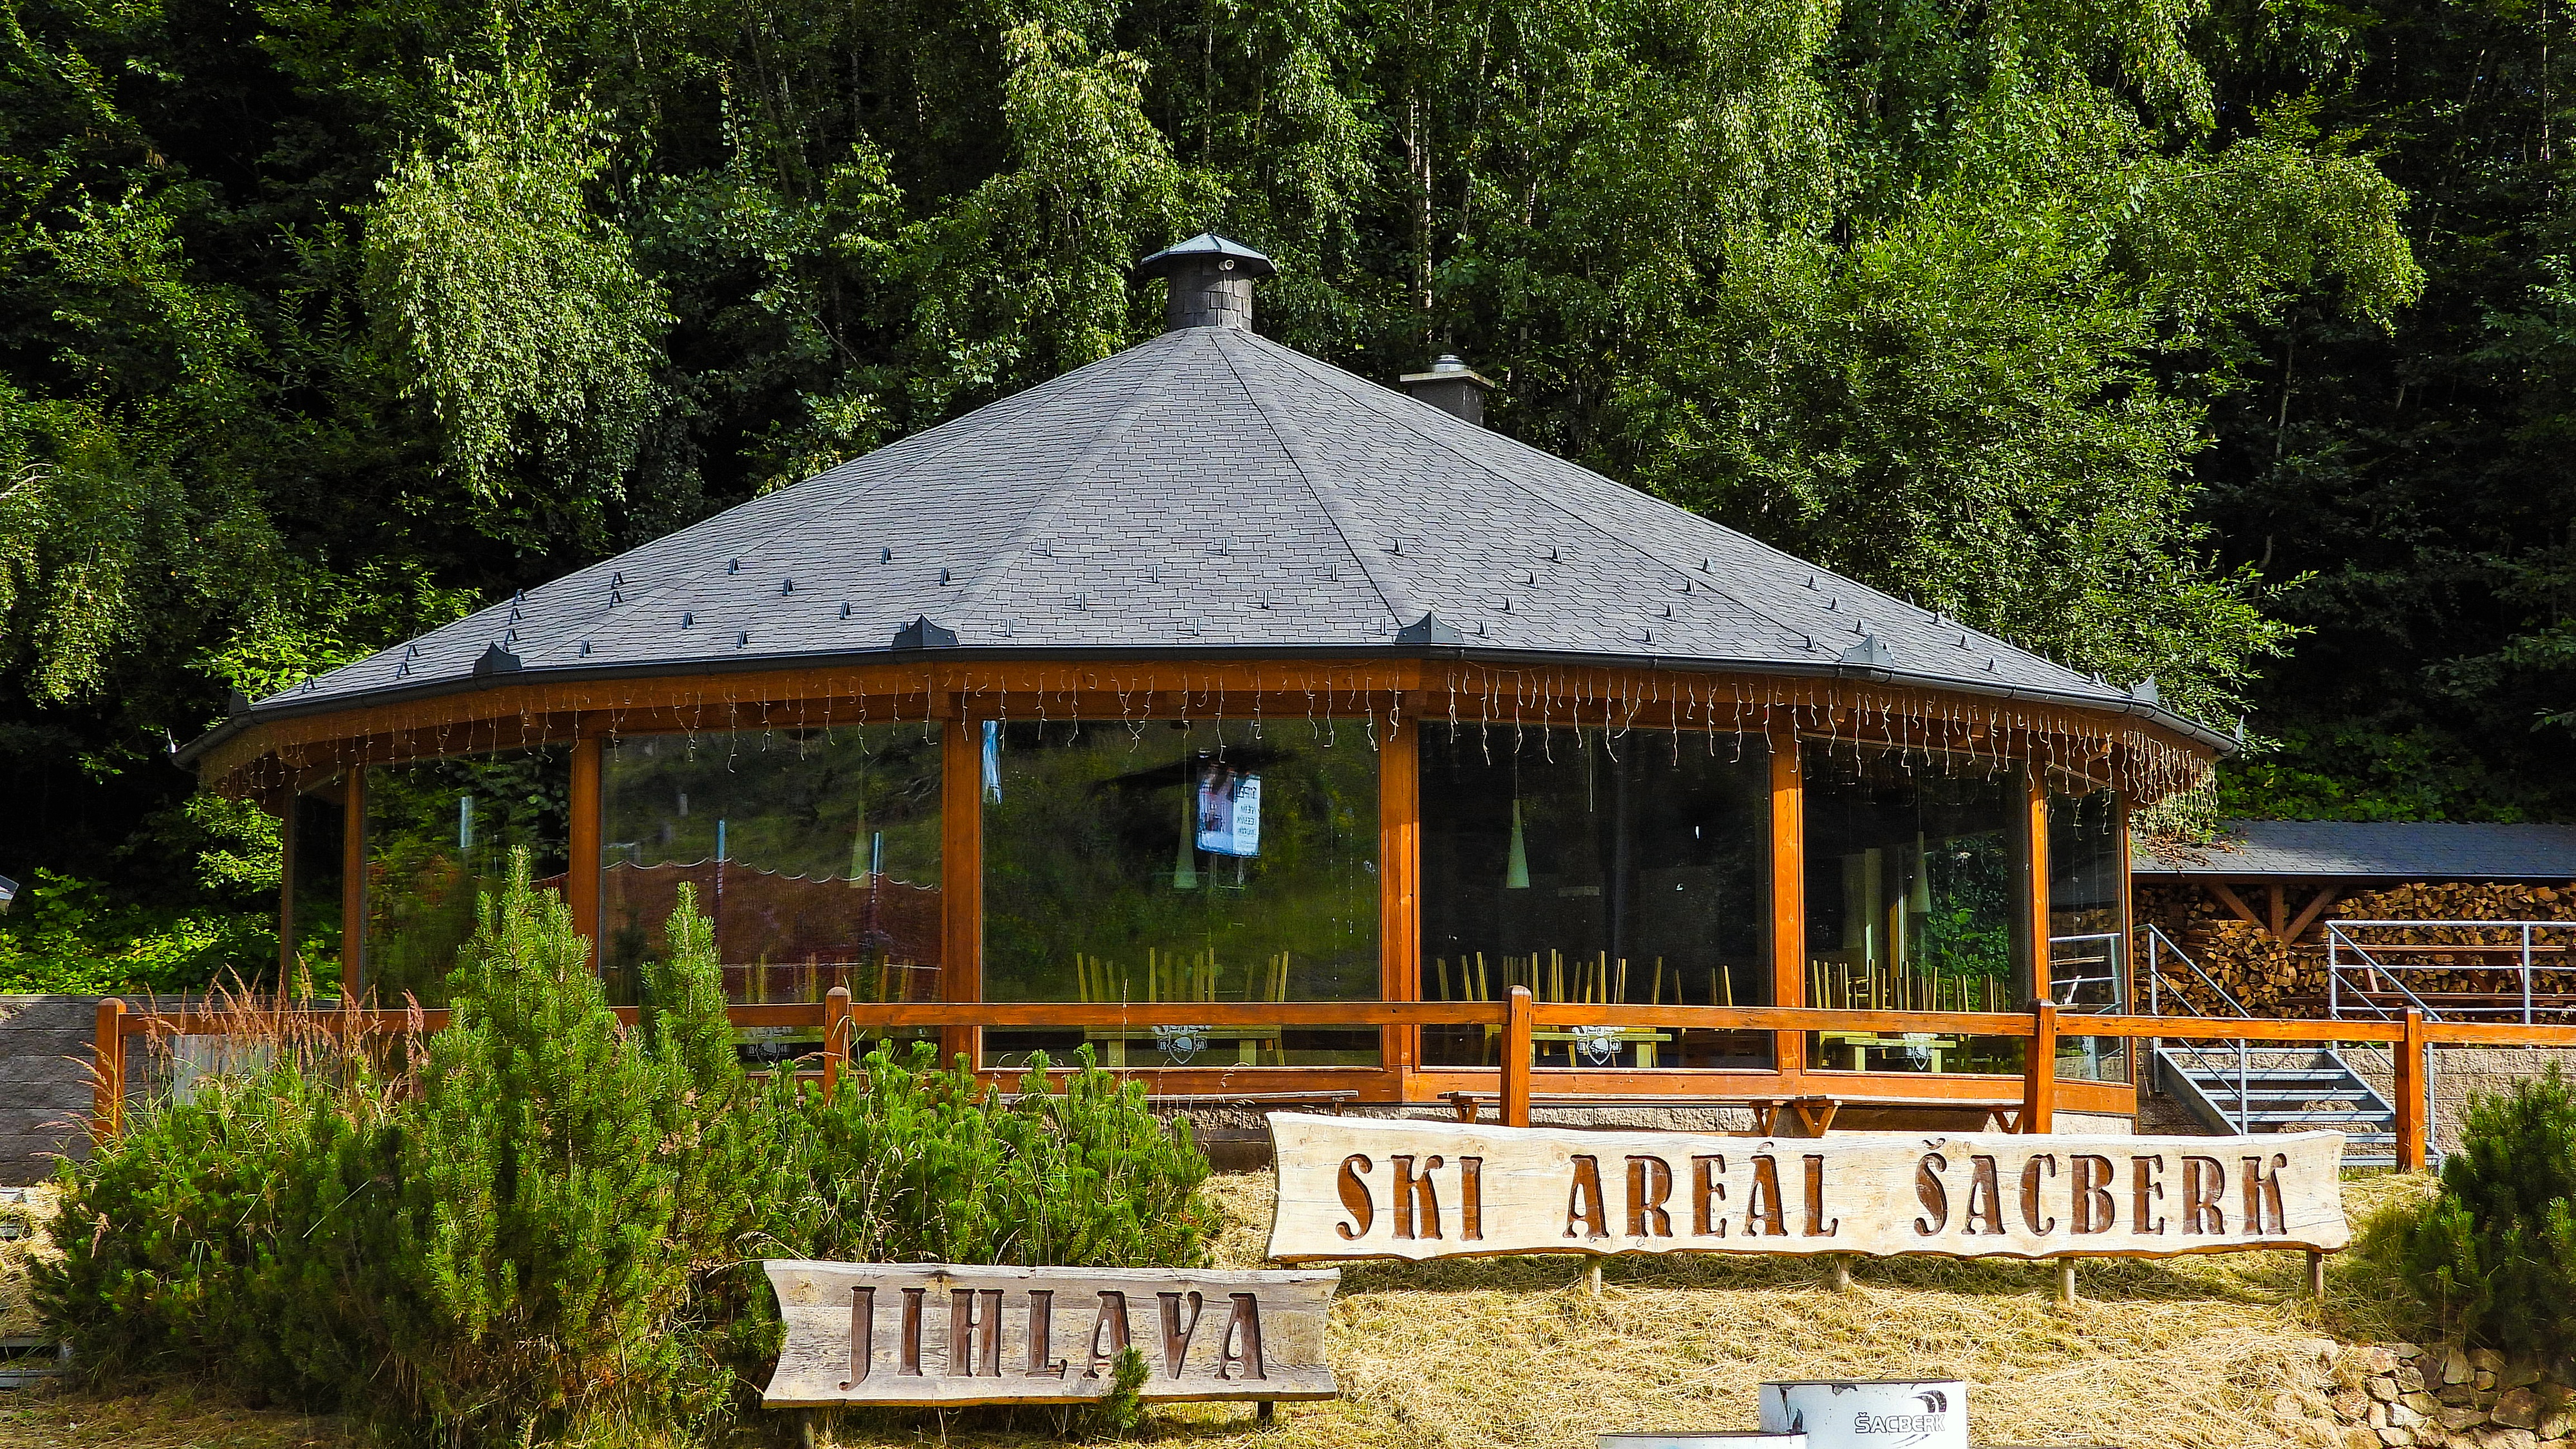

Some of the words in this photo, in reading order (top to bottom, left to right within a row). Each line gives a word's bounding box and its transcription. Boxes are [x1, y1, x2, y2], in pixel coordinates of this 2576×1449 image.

[1336, 1153, 1484, 1241] SKI
[1562, 1141, 1838, 1239] AREÁL
[1913, 1137, 2288, 1237] ŠACBERK
[838, 1286, 1267, 1391] JIHLAVA
[1854, 1412, 1946, 1434] ŠACBERK
